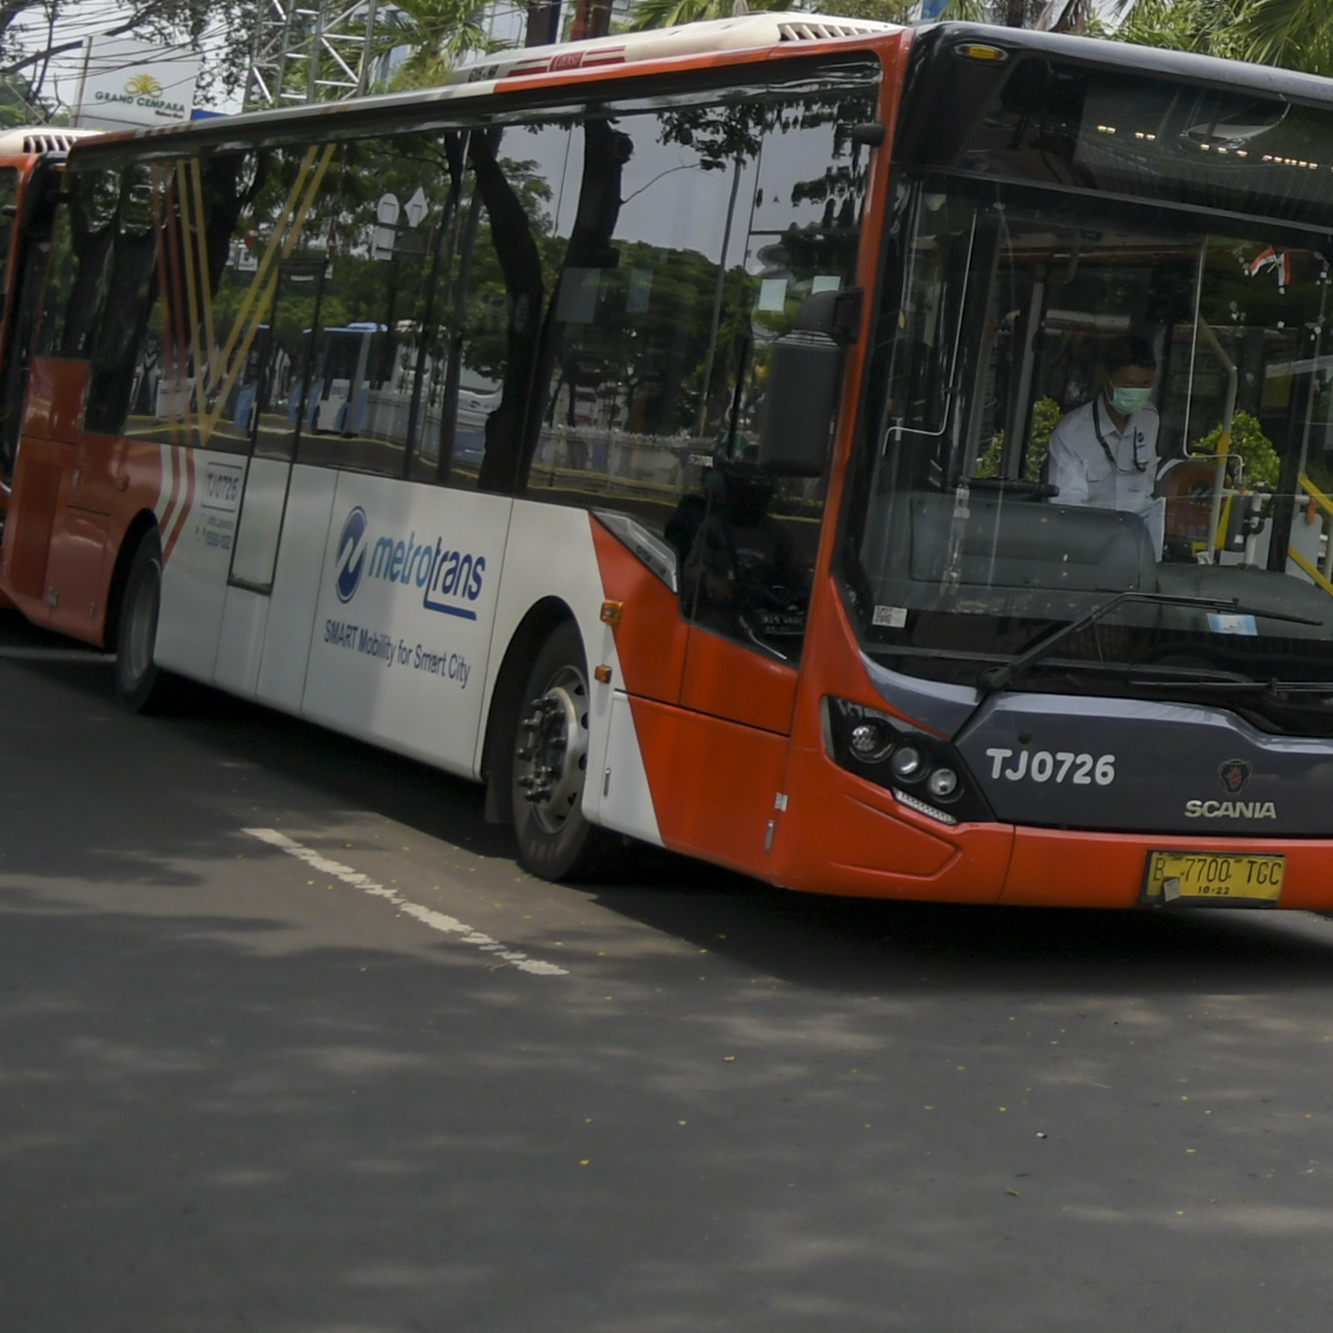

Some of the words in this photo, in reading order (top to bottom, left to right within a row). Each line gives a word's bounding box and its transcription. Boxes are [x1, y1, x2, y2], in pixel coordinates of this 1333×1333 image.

[95, 91, 134, 104] GRAND
[136, 97, 185, 112] CEMPAKA
[368, 531, 486, 609] metrotrans
[324, 619, 358, 650] SMART
[358, 628, 397, 668] Mobility
[397, 639, 413, 665] for
[414, 644, 447, 677] Smart
[448, 653, 472, 689] City
[986, 748, 1115, 786] TJ0726
[1184, 800, 1277, 819] SCANIA
[1153, 857, 1164, 881] B
[1184, 858, 1230, 883] 7700
[1247, 862, 1282, 885] TGC
[1198, 886, 1230, 896] 10-22
